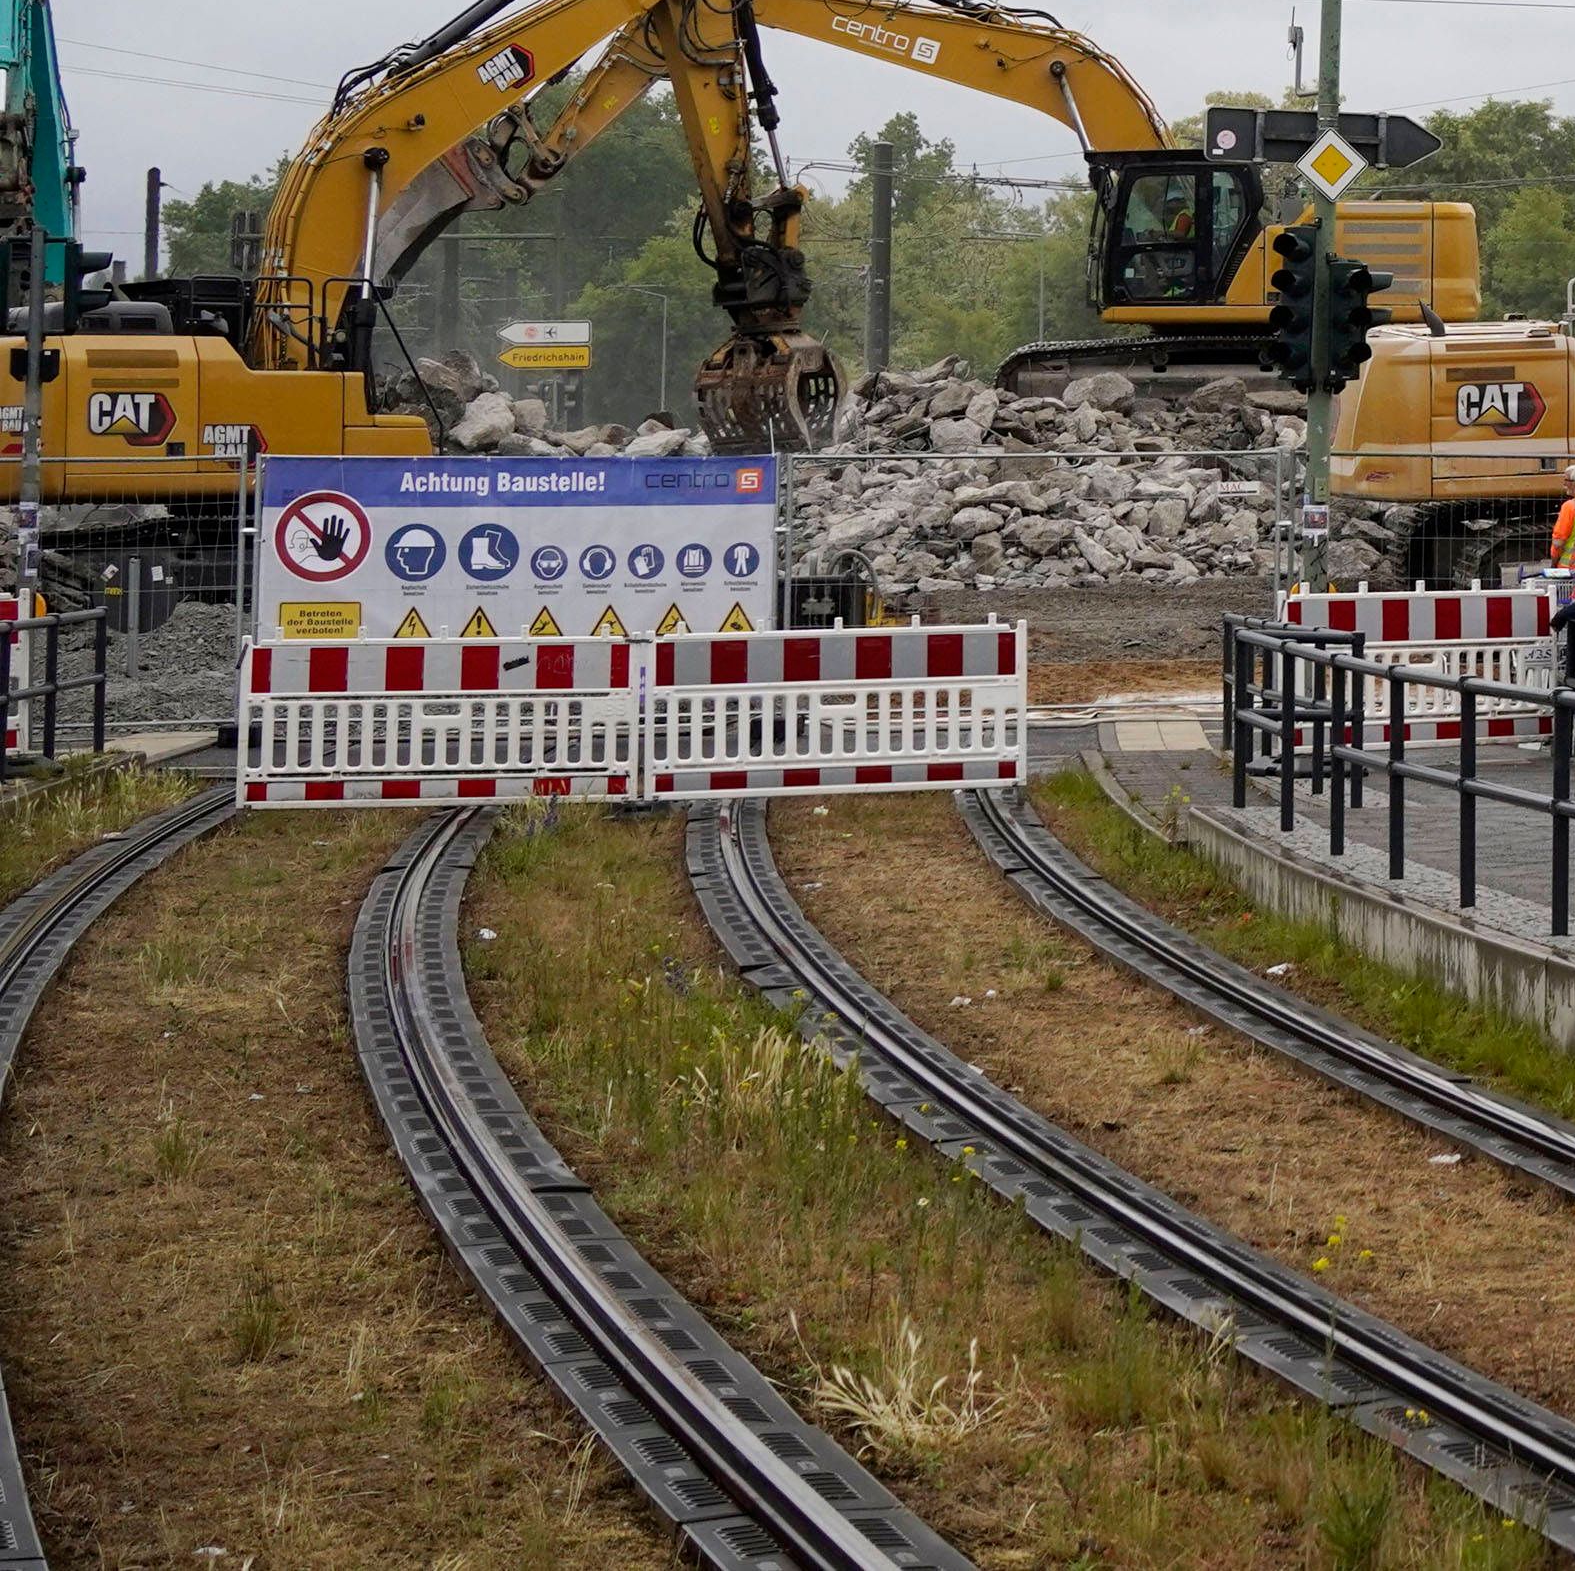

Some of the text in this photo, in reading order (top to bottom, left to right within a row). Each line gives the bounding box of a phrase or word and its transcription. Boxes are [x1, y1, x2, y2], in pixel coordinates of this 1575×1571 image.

[832, 15, 910, 51] centro
[476, 47, 518, 85] AGMT
[494, 63, 525, 93] BAU
[512, 352, 585, 363] Friedrichshain
[89, 392, 156, 434] CAT
[1457, 383, 1524, 426] CAT
[203, 425, 251, 445] AGMT
[400, 472, 490, 496] Achtung
[496, 471, 605, 492] Baustelle!
[645, 469, 730, 489] centro
[287, 617, 354, 627] der Baustelle
[299, 609, 343, 618] Betreten
[296, 625, 344, 635] verboten!
